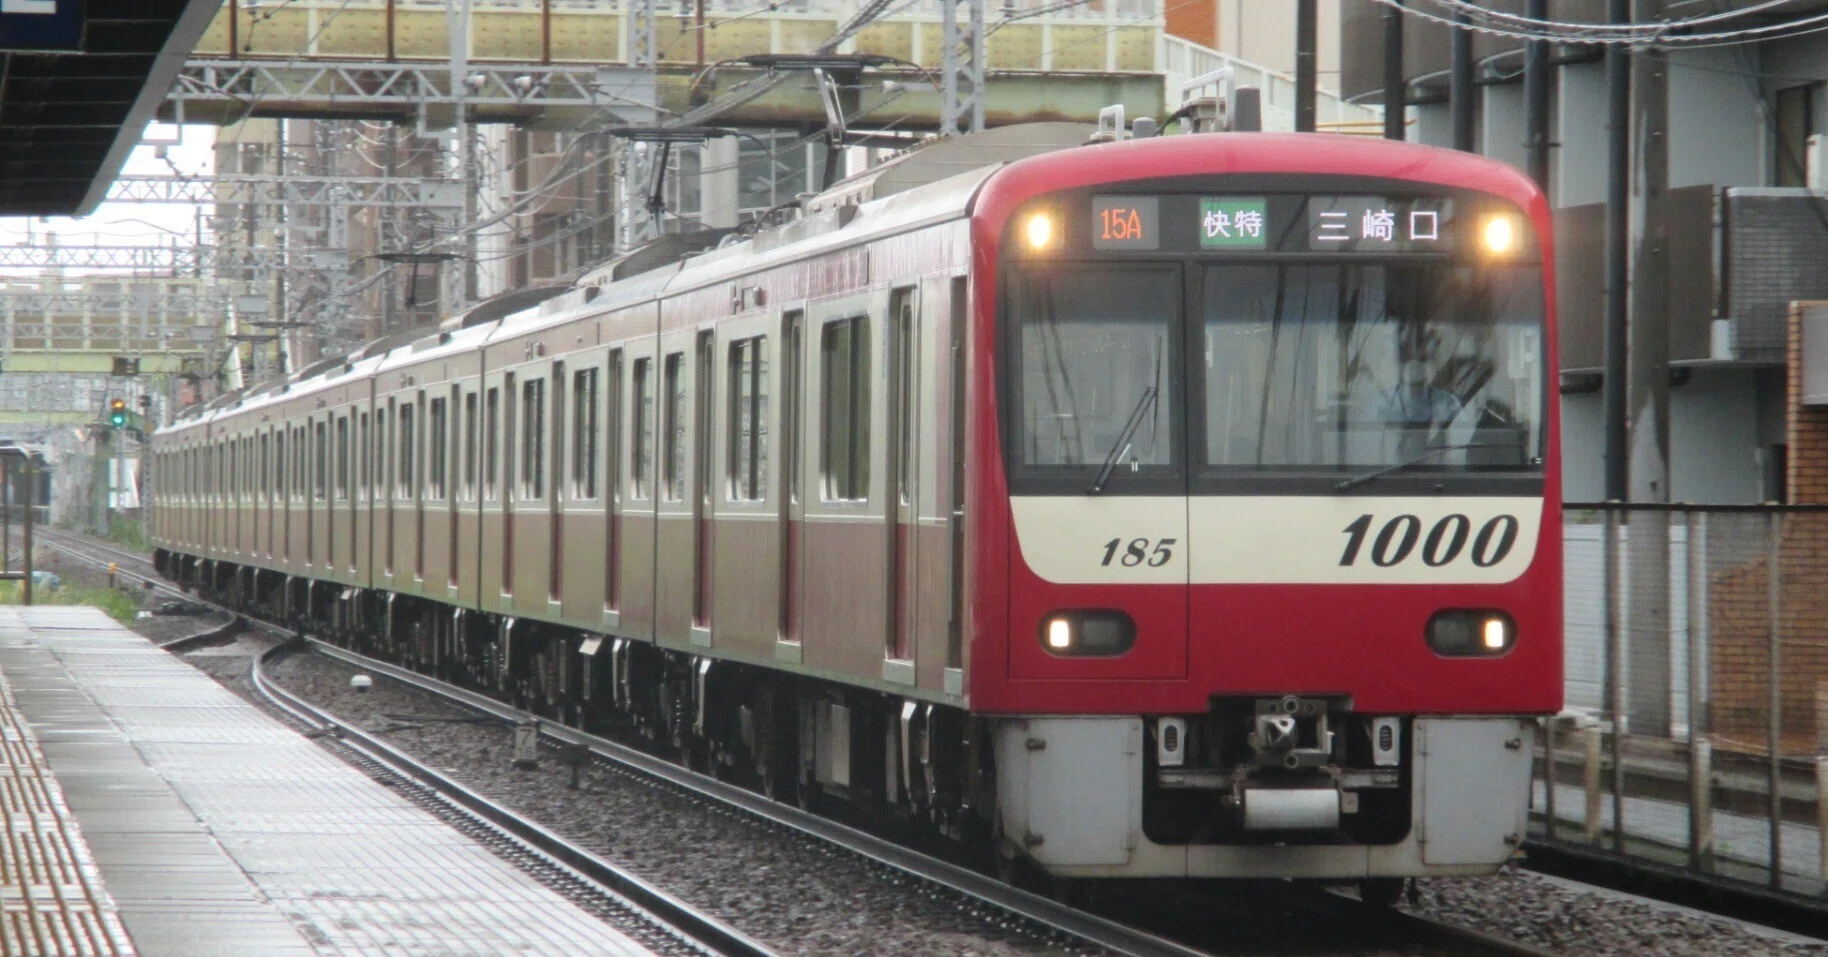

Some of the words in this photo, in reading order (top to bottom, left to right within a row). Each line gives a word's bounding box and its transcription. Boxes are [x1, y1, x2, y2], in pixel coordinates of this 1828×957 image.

[1101, 209, 1142, 239] 15A
[1203, 210, 1263, 238] 快特
[1317, 209, 1438, 241] 三崎口
[1101, 537, 1178, 567] 185
[1338, 513, 1519, 568] 1000
